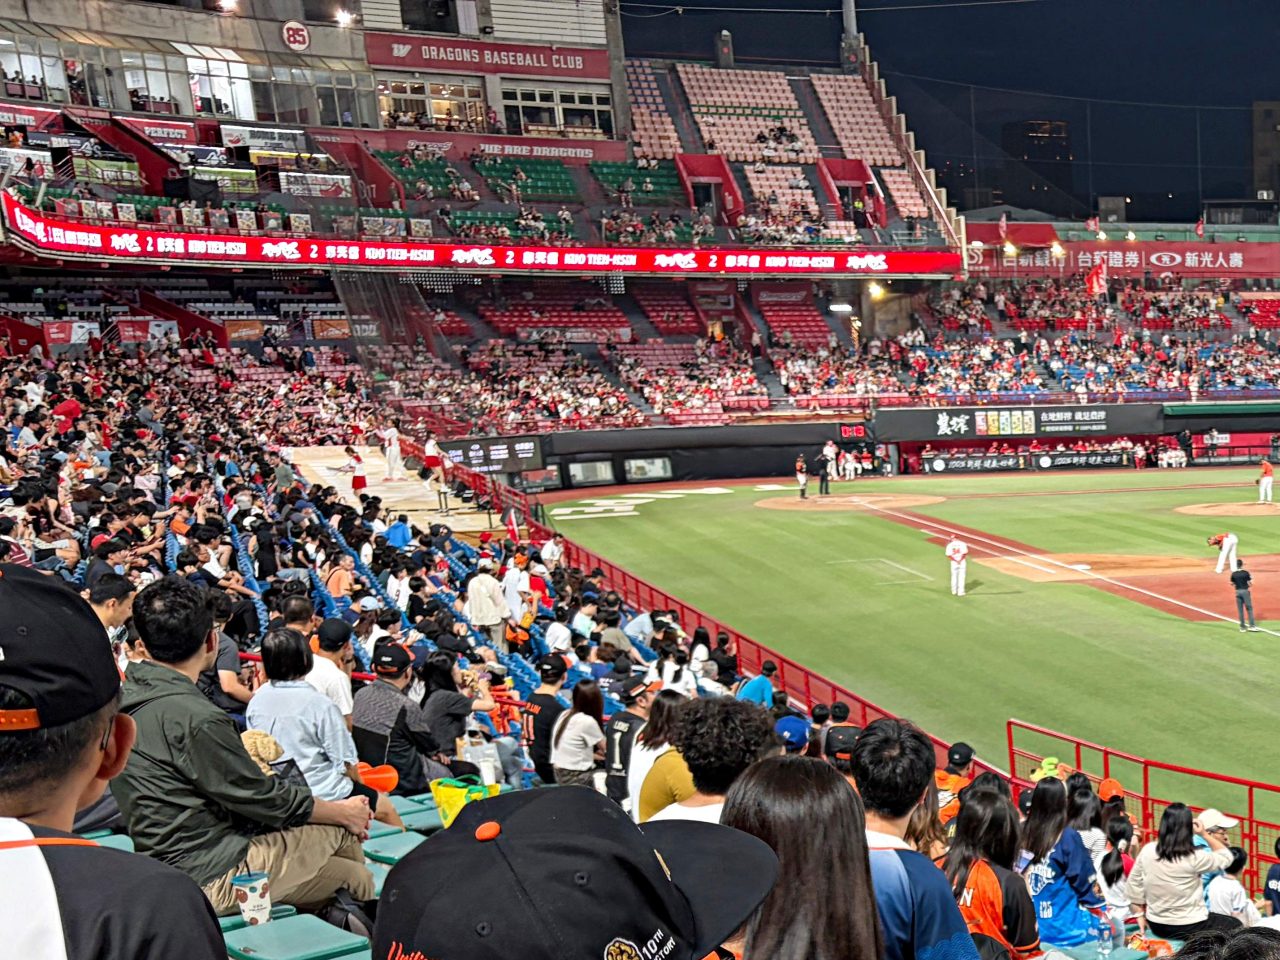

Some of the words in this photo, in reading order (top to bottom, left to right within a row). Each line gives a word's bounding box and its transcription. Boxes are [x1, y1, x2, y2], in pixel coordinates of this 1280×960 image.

[287, 27, 308, 47] 85
[422, 46, 479, 63] DRAGONS
[485, 51, 547, 68] BASEBALL
[552, 55, 583, 69] CLUB
[504, 146, 531, 156] ARE
[533, 147, 593, 158] DRAGONS
[310, 244, 318, 259] 2
[505, 251, 515, 264] 2
[1077, 251, 1139, 268] 台新證券
[1184, 252, 1243, 268] 新光人壽
[709, 255, 718, 268] 2
[612, 731, 624, 769] 1
[642, 928, 664, 960] 10TH
